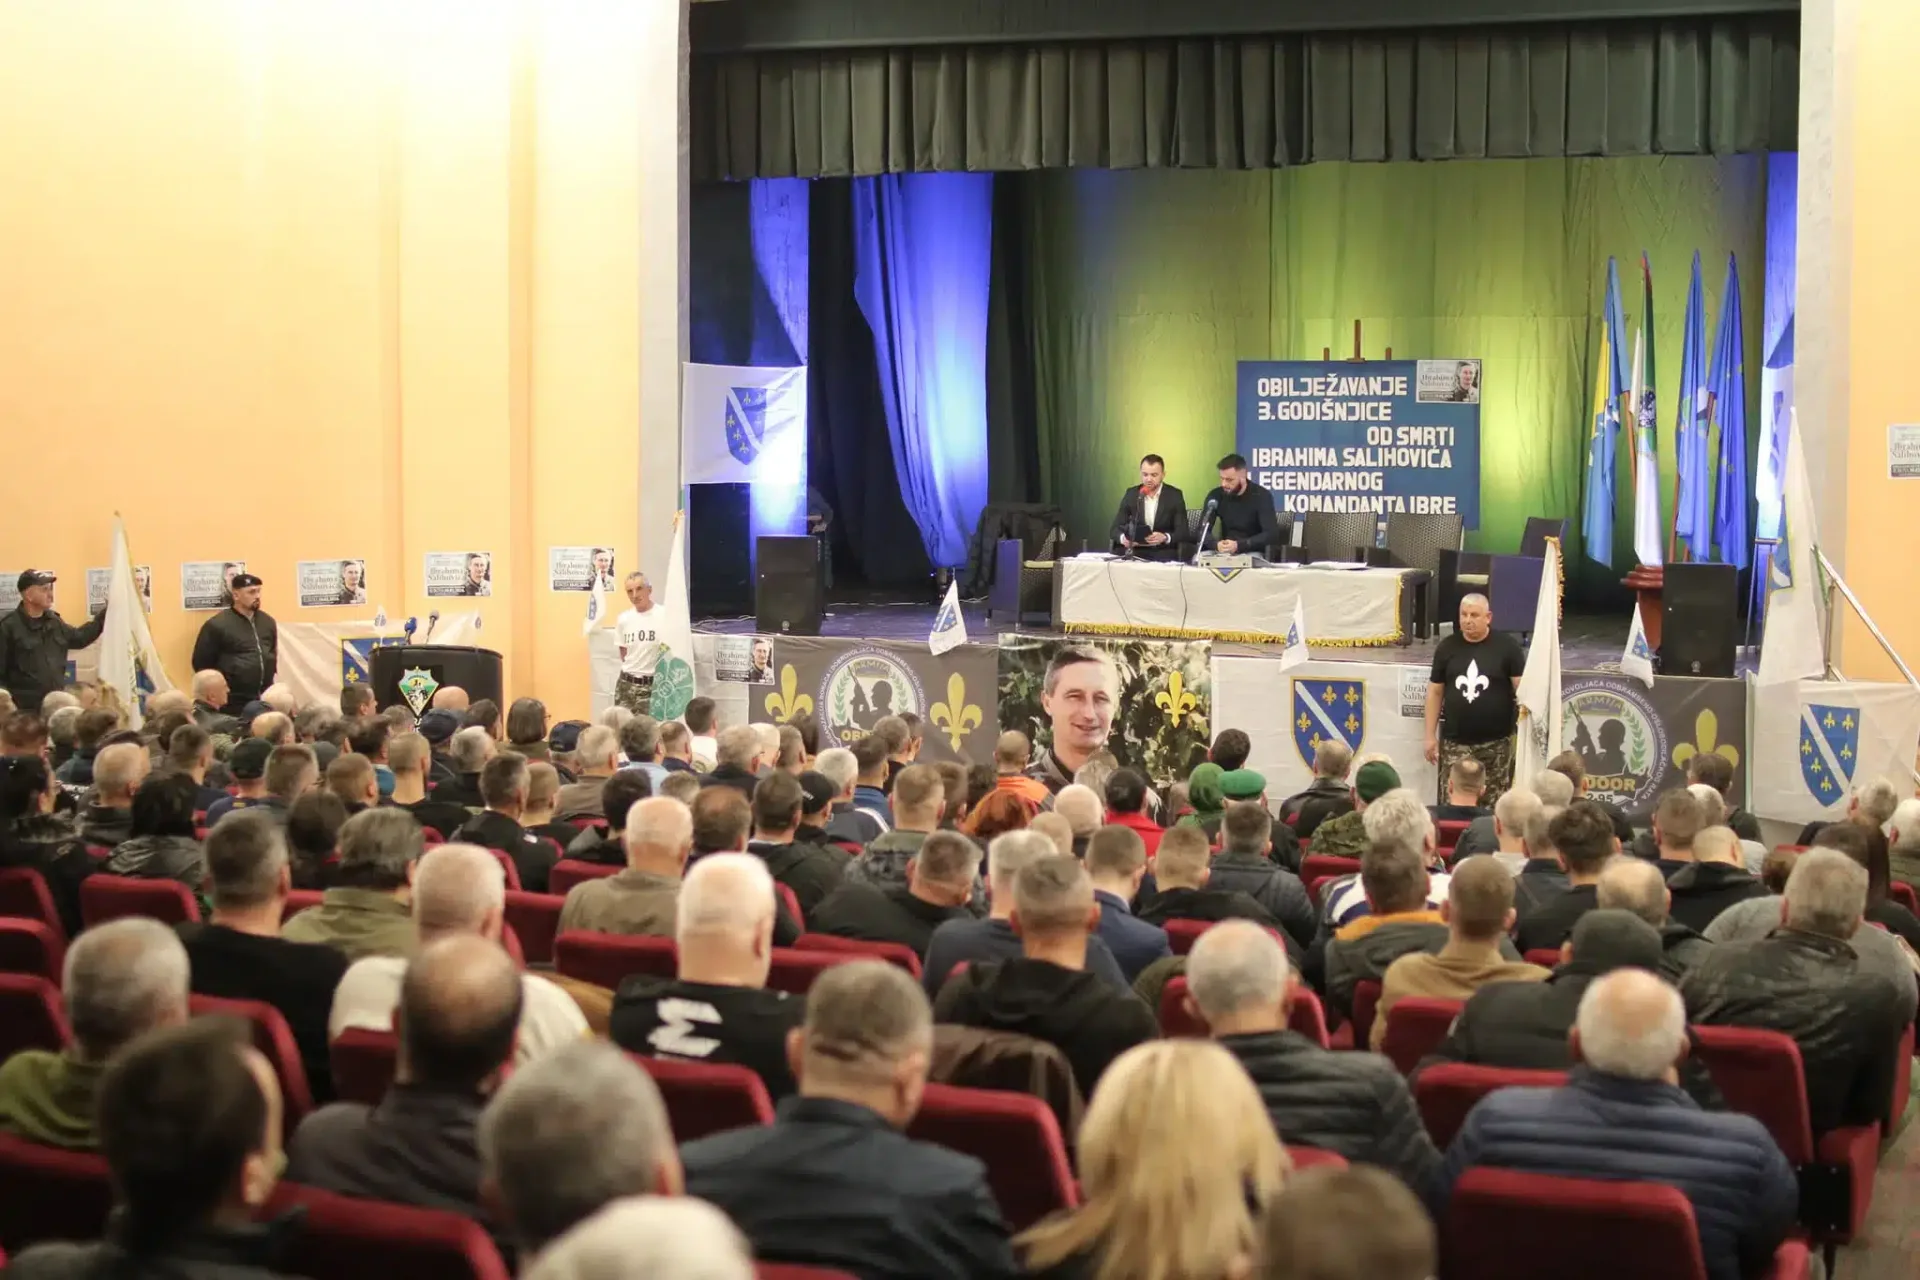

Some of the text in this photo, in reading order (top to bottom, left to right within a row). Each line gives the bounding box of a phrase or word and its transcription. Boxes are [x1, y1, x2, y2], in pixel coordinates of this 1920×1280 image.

[1257, 373, 1408, 397] OBILJEŽAVANJE
[1366, 426, 1455, 446] OD SMRTI
[1252, 445, 1452, 468] IBRAHIMA SALIHOVIĆA
[1283, 494, 1456, 515] KOMANDANTA IBRE
